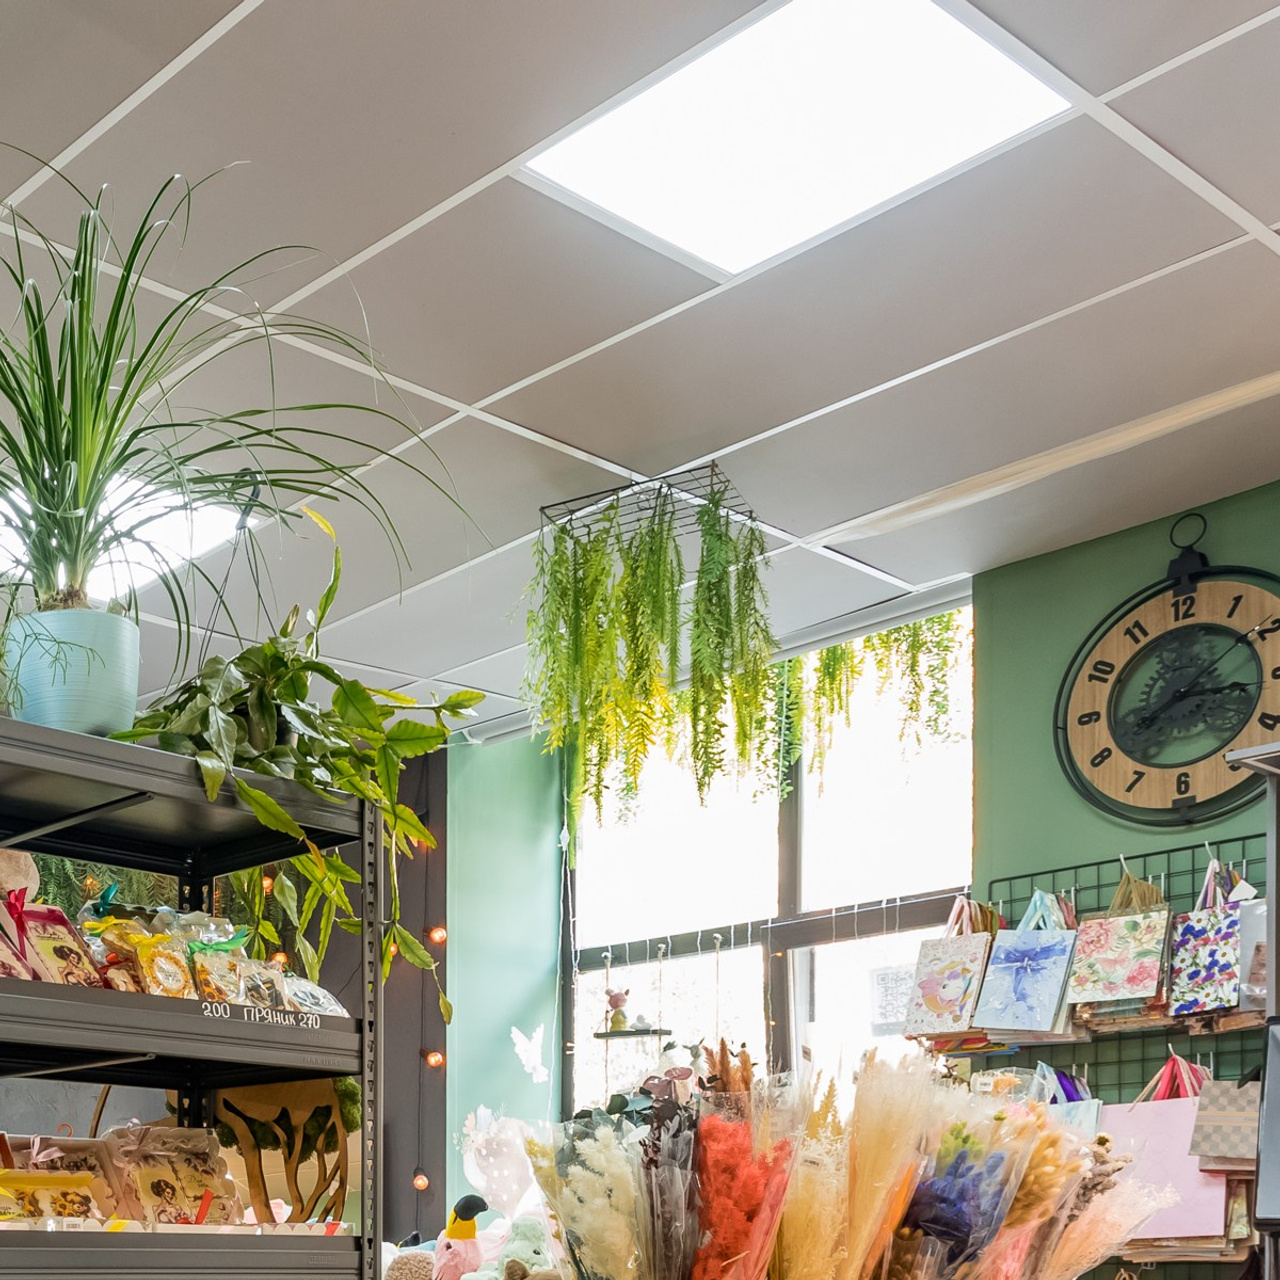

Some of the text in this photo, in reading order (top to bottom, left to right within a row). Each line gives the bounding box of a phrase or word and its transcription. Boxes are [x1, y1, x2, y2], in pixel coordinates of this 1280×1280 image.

[1170, 595, 1196, 622] 12
[1226, 594, 1244, 619] 1
[1123, 619, 1150, 645] 11
[1256, 618, 1280, 642] 2
[1087, 660, 1116, 684] 10
[1077, 710, 1102, 727] 9
[1090, 747, 1113, 768] 8
[1125, 770, 1146, 794] 7
[1176, 772, 1191, 796] 6
[202, 1002, 231, 1018] 200
[298, 1013, 321, 1029] 270
